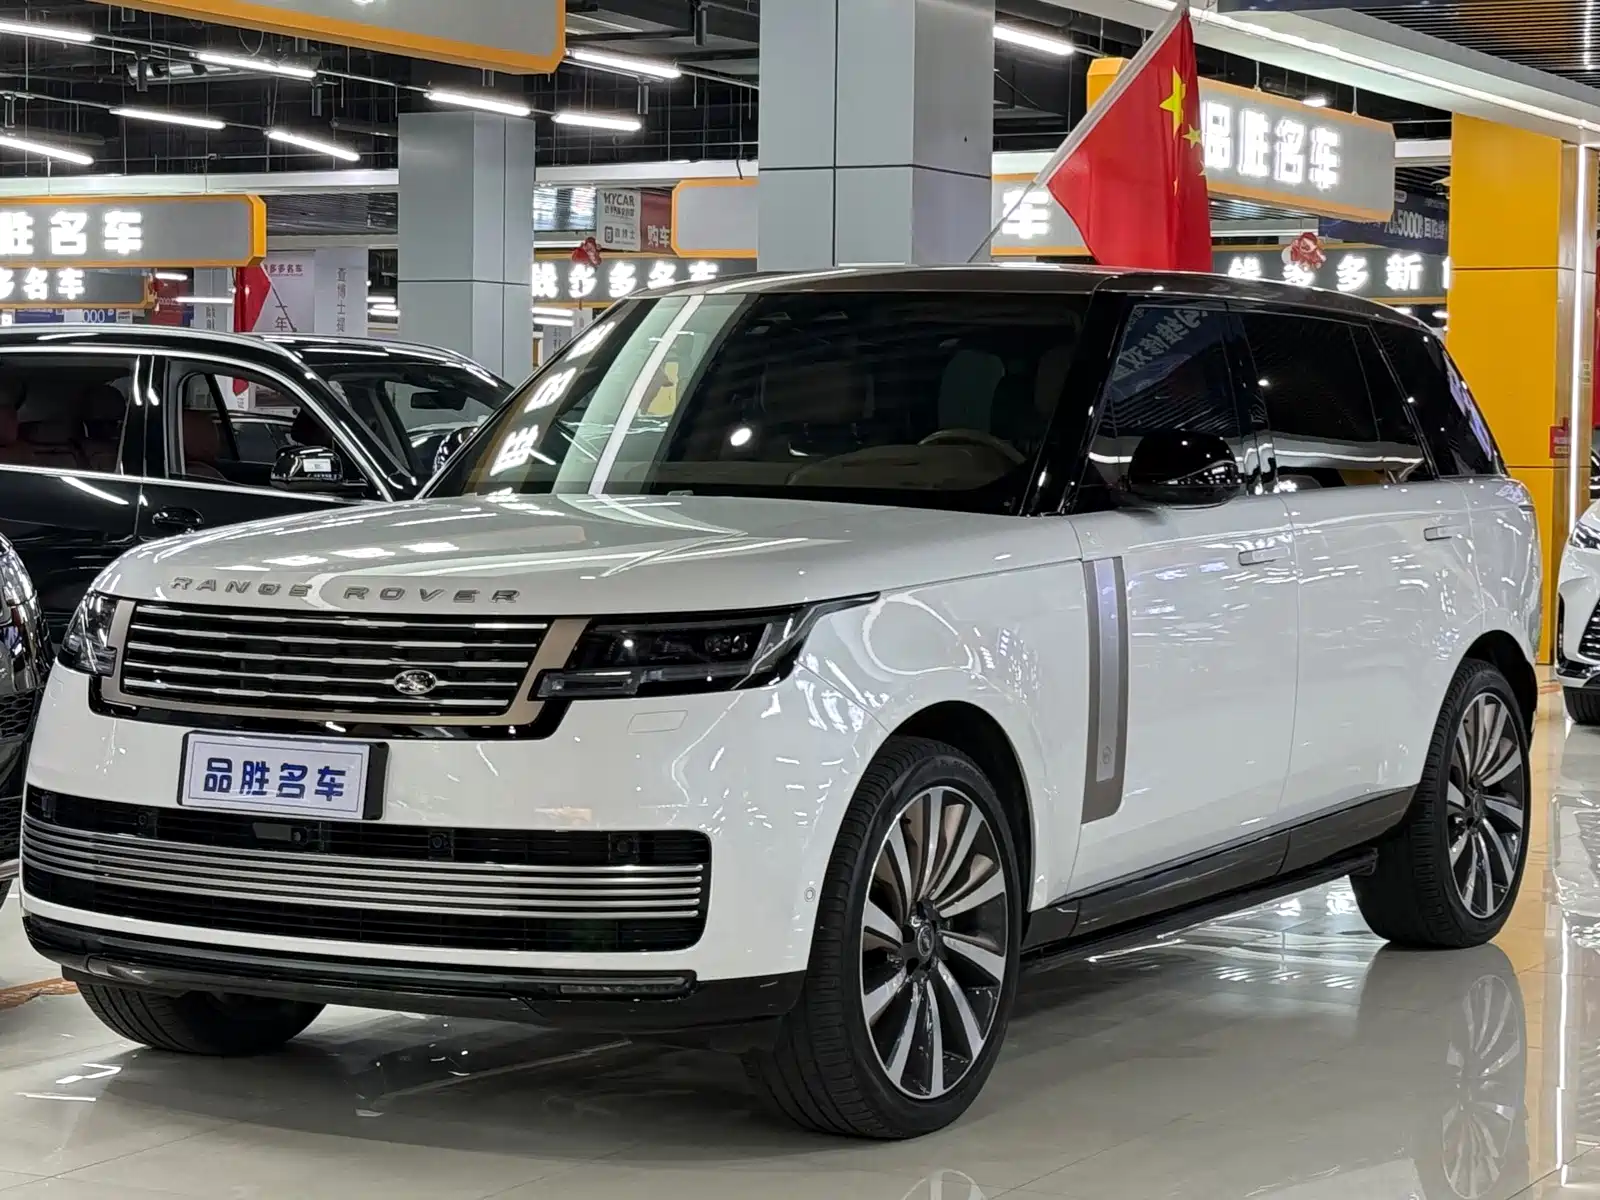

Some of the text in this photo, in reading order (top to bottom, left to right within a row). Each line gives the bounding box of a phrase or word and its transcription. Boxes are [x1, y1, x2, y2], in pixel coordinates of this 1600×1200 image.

[1201, 100, 1340, 190] 品胜名车
[1002, 188, 1051, 240] 车
[264, 264, 304, 273] 多多名车
[170, 576, 521, 603] RANGE ROVER
[204, 756, 347, 802] 品胜名车
